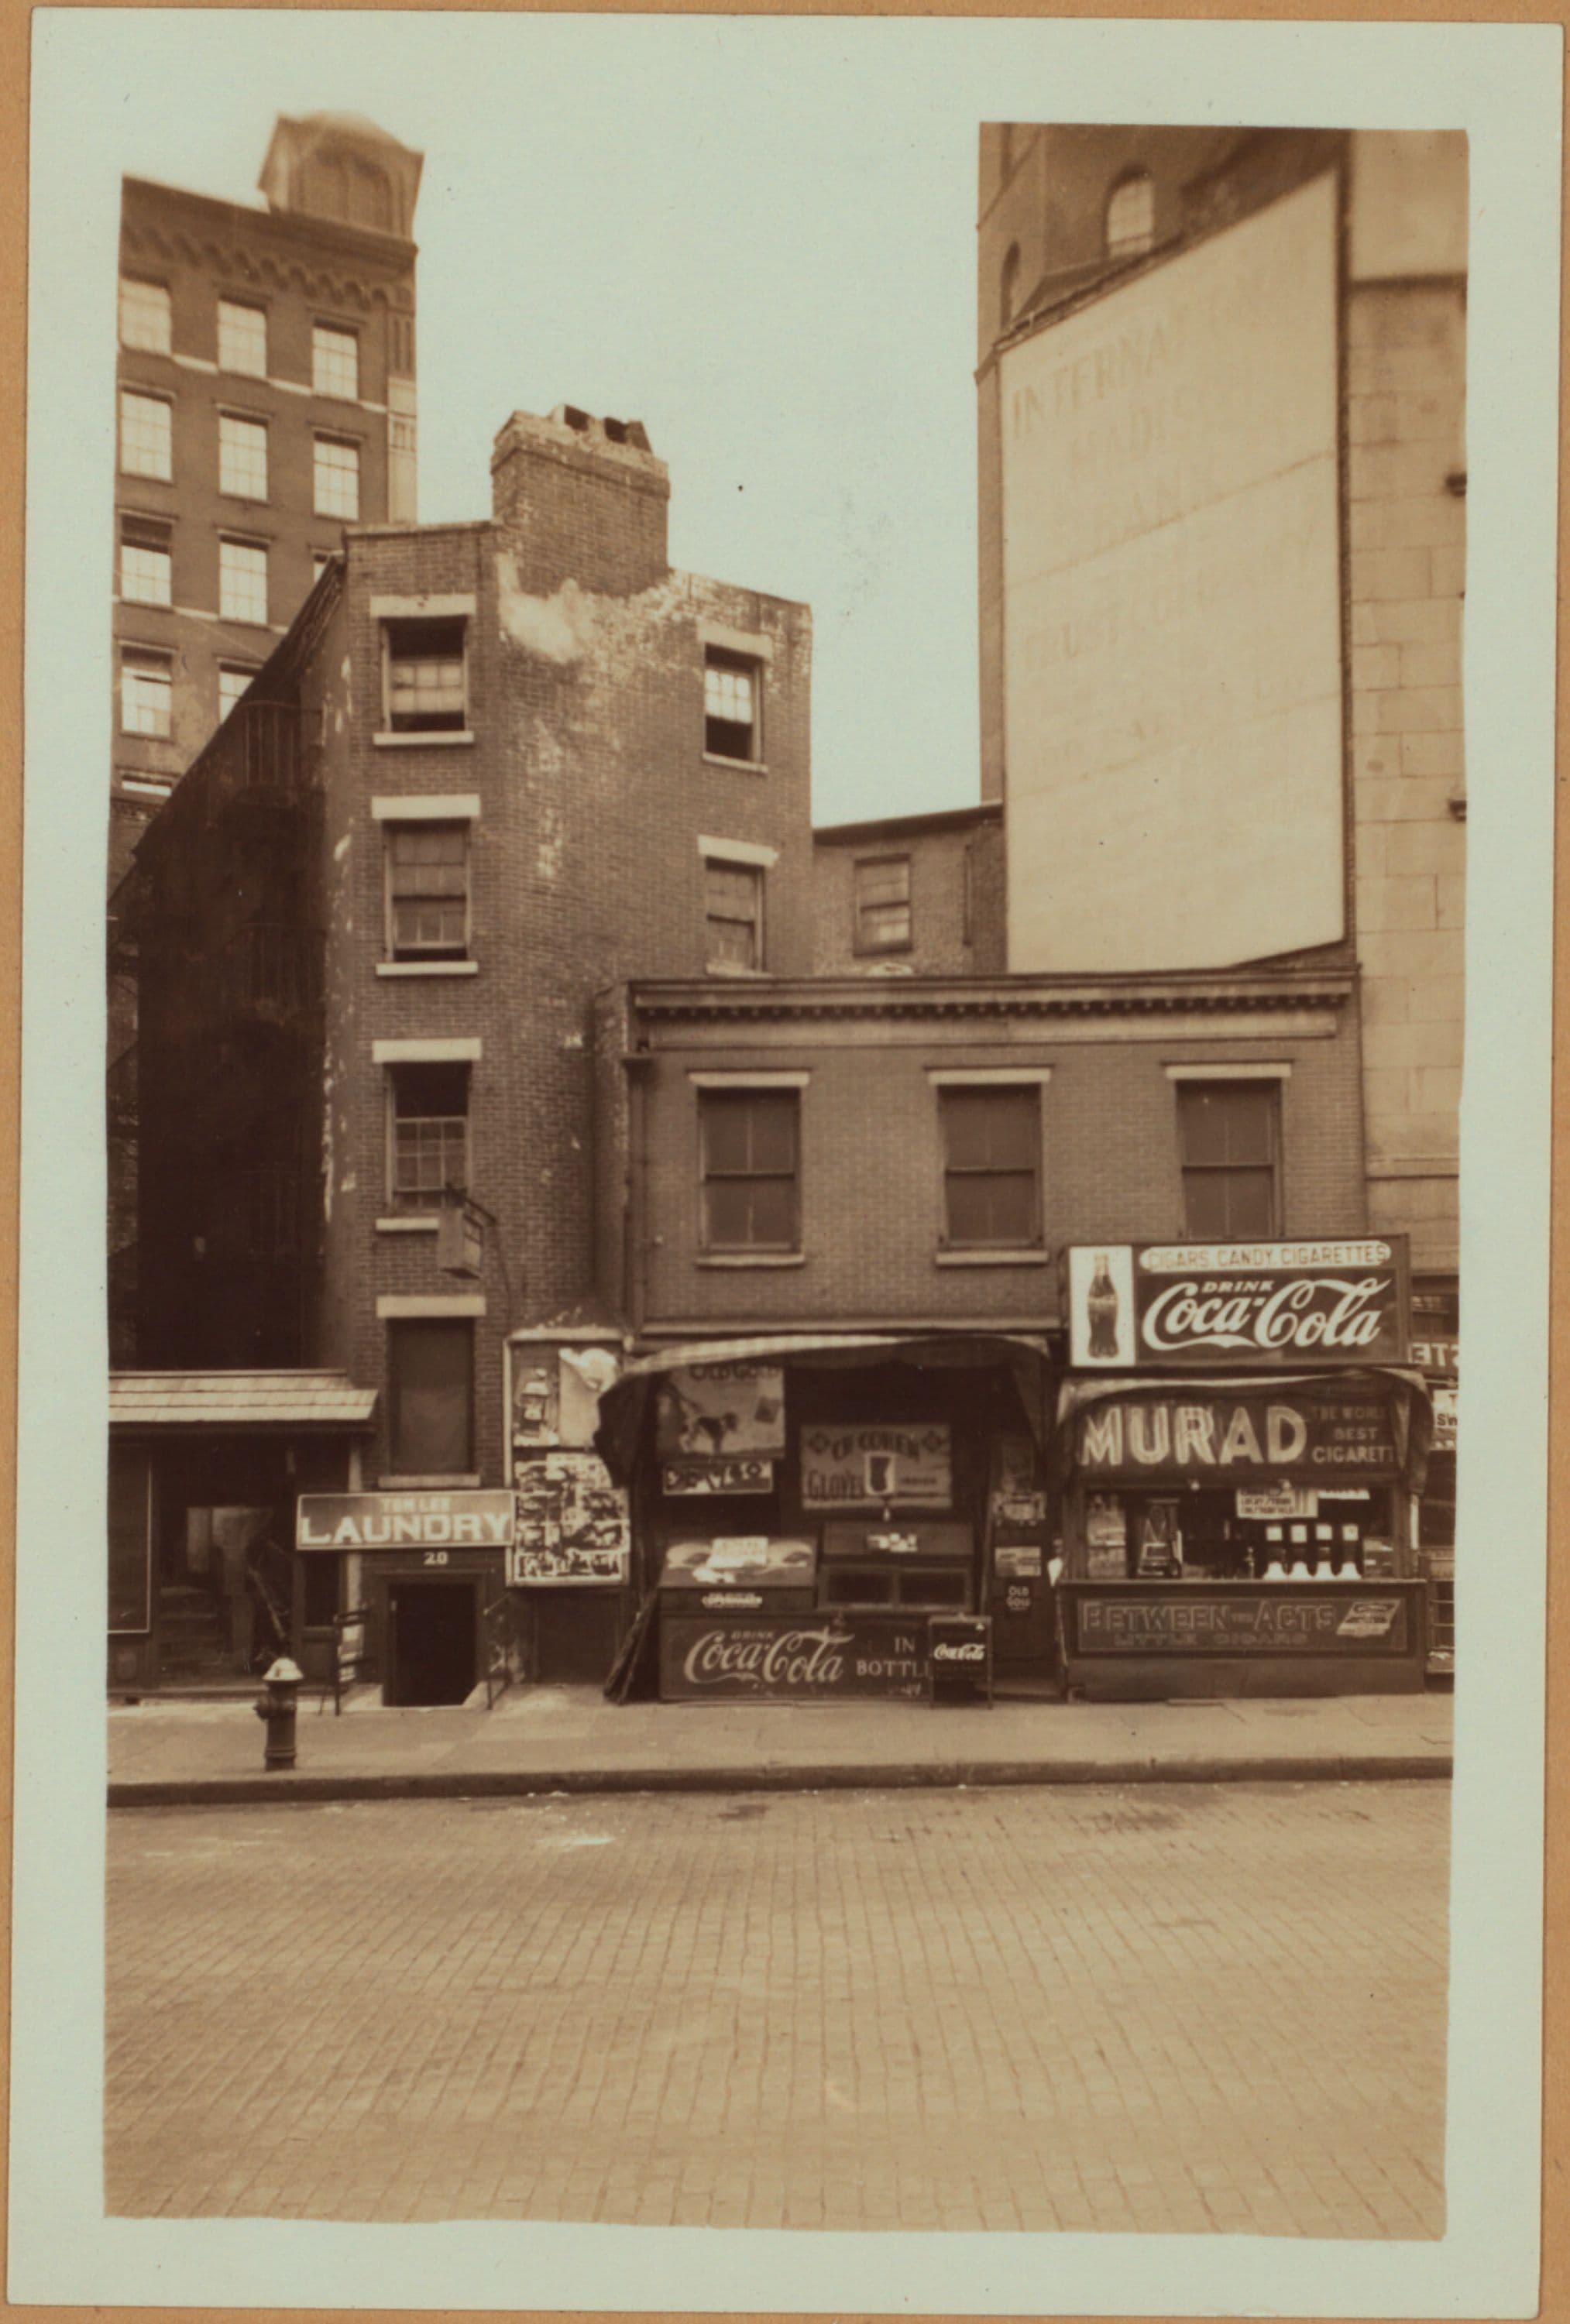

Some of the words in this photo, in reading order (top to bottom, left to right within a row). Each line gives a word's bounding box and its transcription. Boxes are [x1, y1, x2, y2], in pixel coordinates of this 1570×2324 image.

[1280, 1244, 1387, 1265] CIGARETTES
[1201, 1280, 1276, 1293] DRINK
[1141, 1277, 1393, 1351] Coca-Cola
[1079, 1403, 1308, 1466] MURAD
[1335, 1427, 1379, 1441] BEST
[1312, 1445, 1394, 1464] CIGARETT
[301, 1512, 510, 1545] LAUNDRY
[1082, 1600, 1231, 1631] BETWEEN
[1255, 1598, 1334, 1631] ACTS
[893, 1636, 916, 1654] IN
[684, 1629, 856, 1684] Coca-Cola
[856, 1659, 930, 1677] BOTTL
